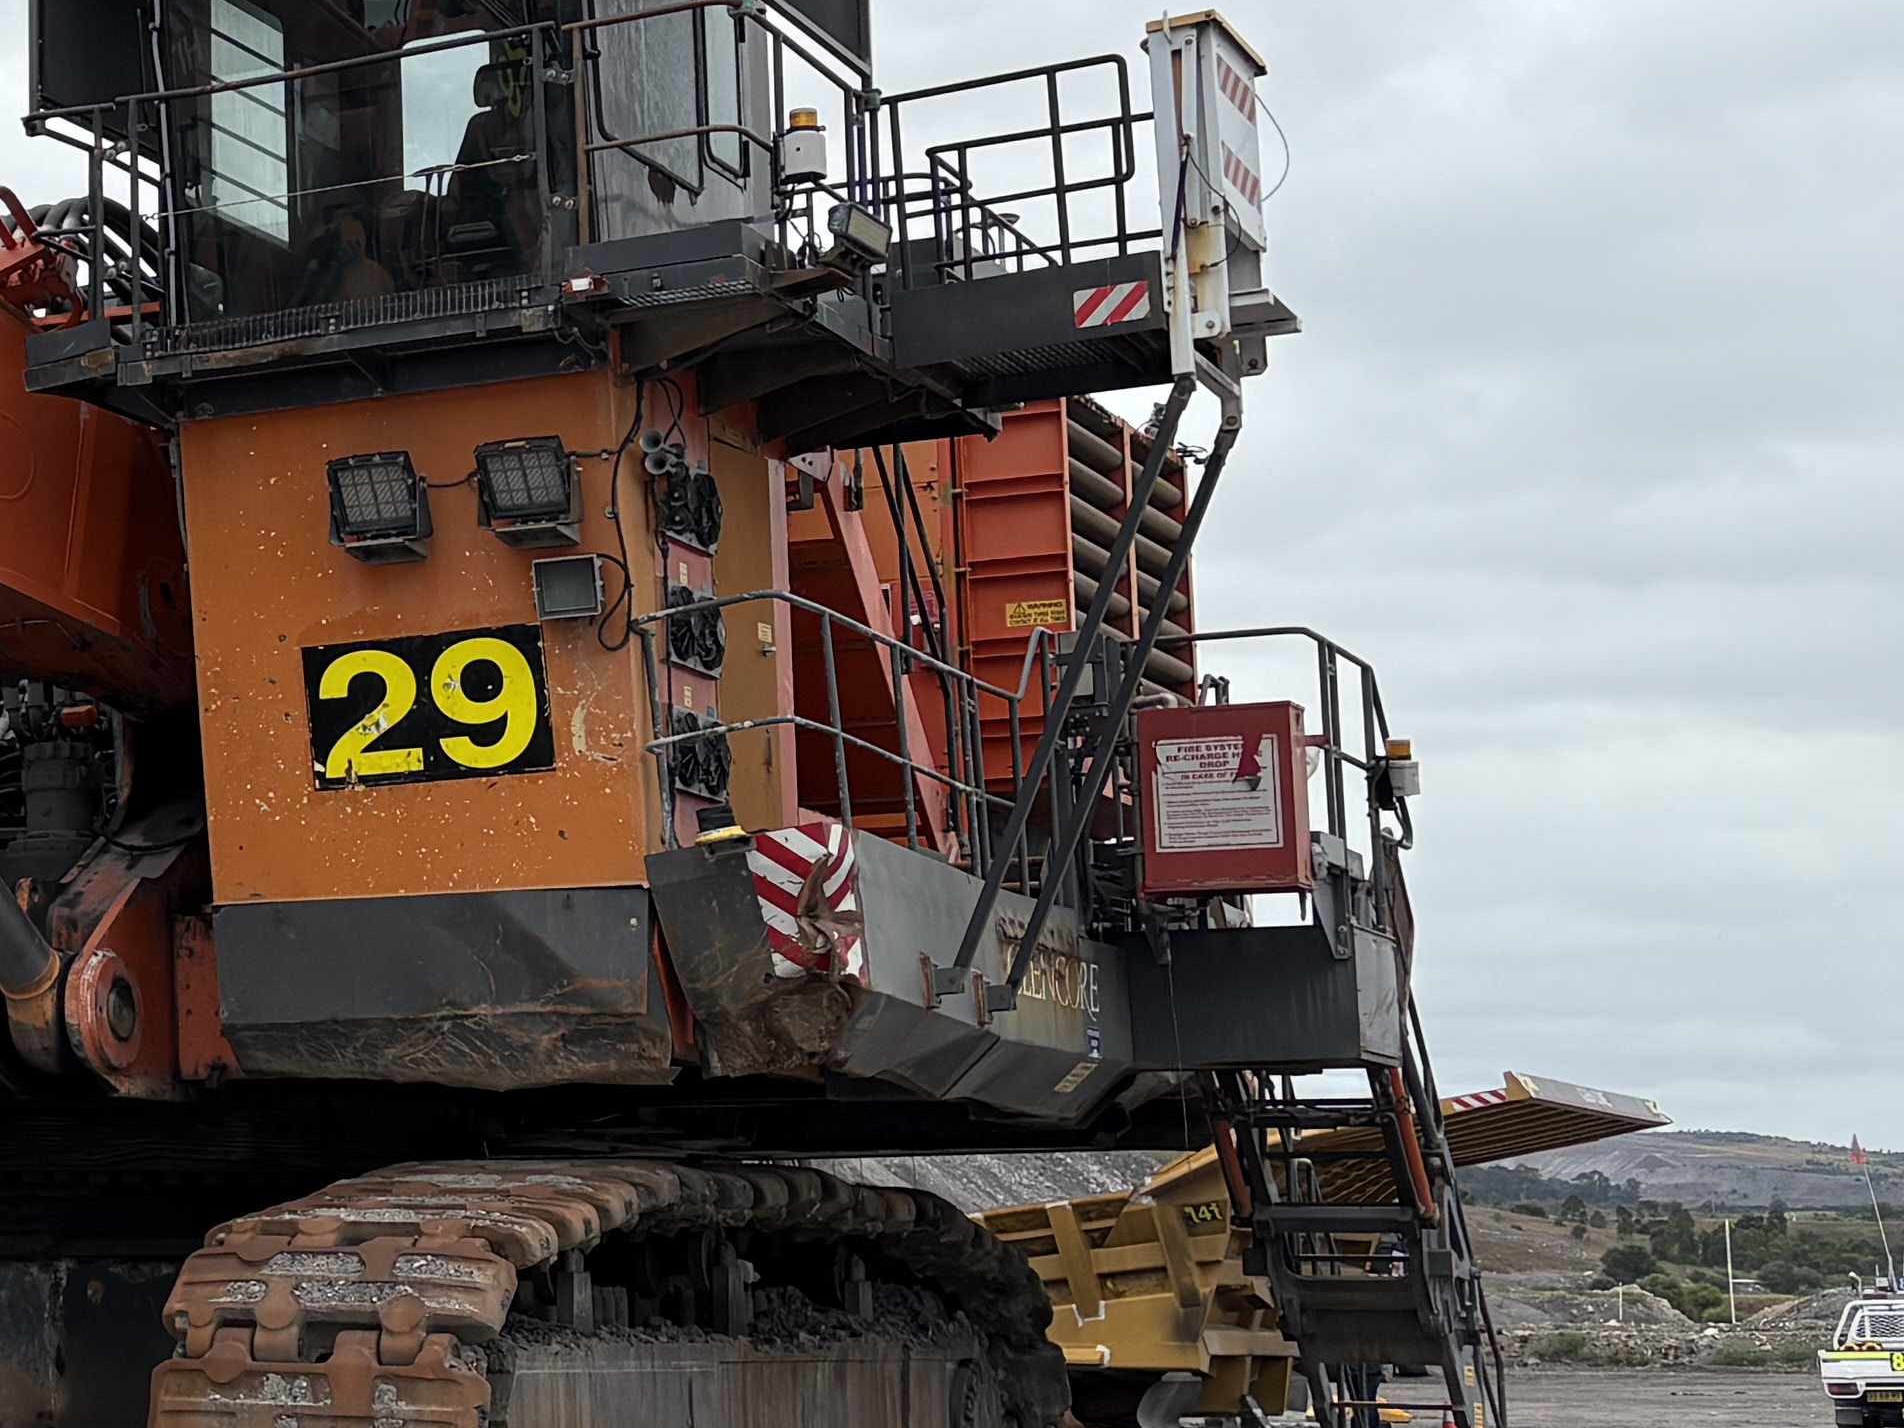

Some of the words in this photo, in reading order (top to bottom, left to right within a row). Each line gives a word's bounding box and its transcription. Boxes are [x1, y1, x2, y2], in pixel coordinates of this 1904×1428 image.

[318, 637, 538, 779] 29
[1177, 745, 1202, 753] FIRE
[1205, 743, 1244, 752] SYSTE
[1166, 752, 1229, 763] RE-CHARGE
[1199, 760, 1230, 768] DROP
